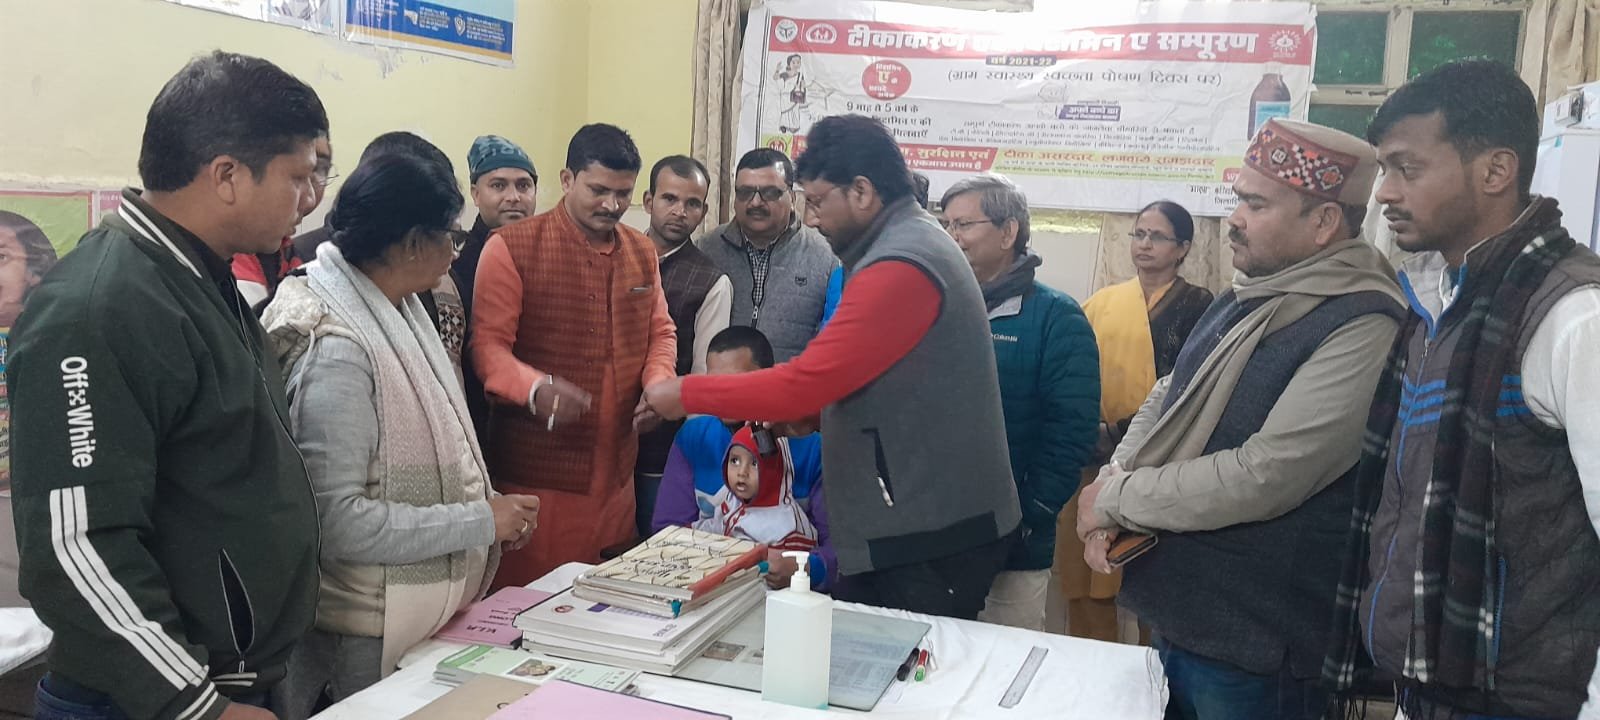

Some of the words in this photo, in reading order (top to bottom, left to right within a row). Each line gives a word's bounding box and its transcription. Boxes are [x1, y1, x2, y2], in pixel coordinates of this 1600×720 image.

[847, 24, 968, 51] टीकाकरण
[1009, 56, 1052, 66] 2021-22
[846, 101, 854, 111] 9
[885, 102, 892, 112] 5
